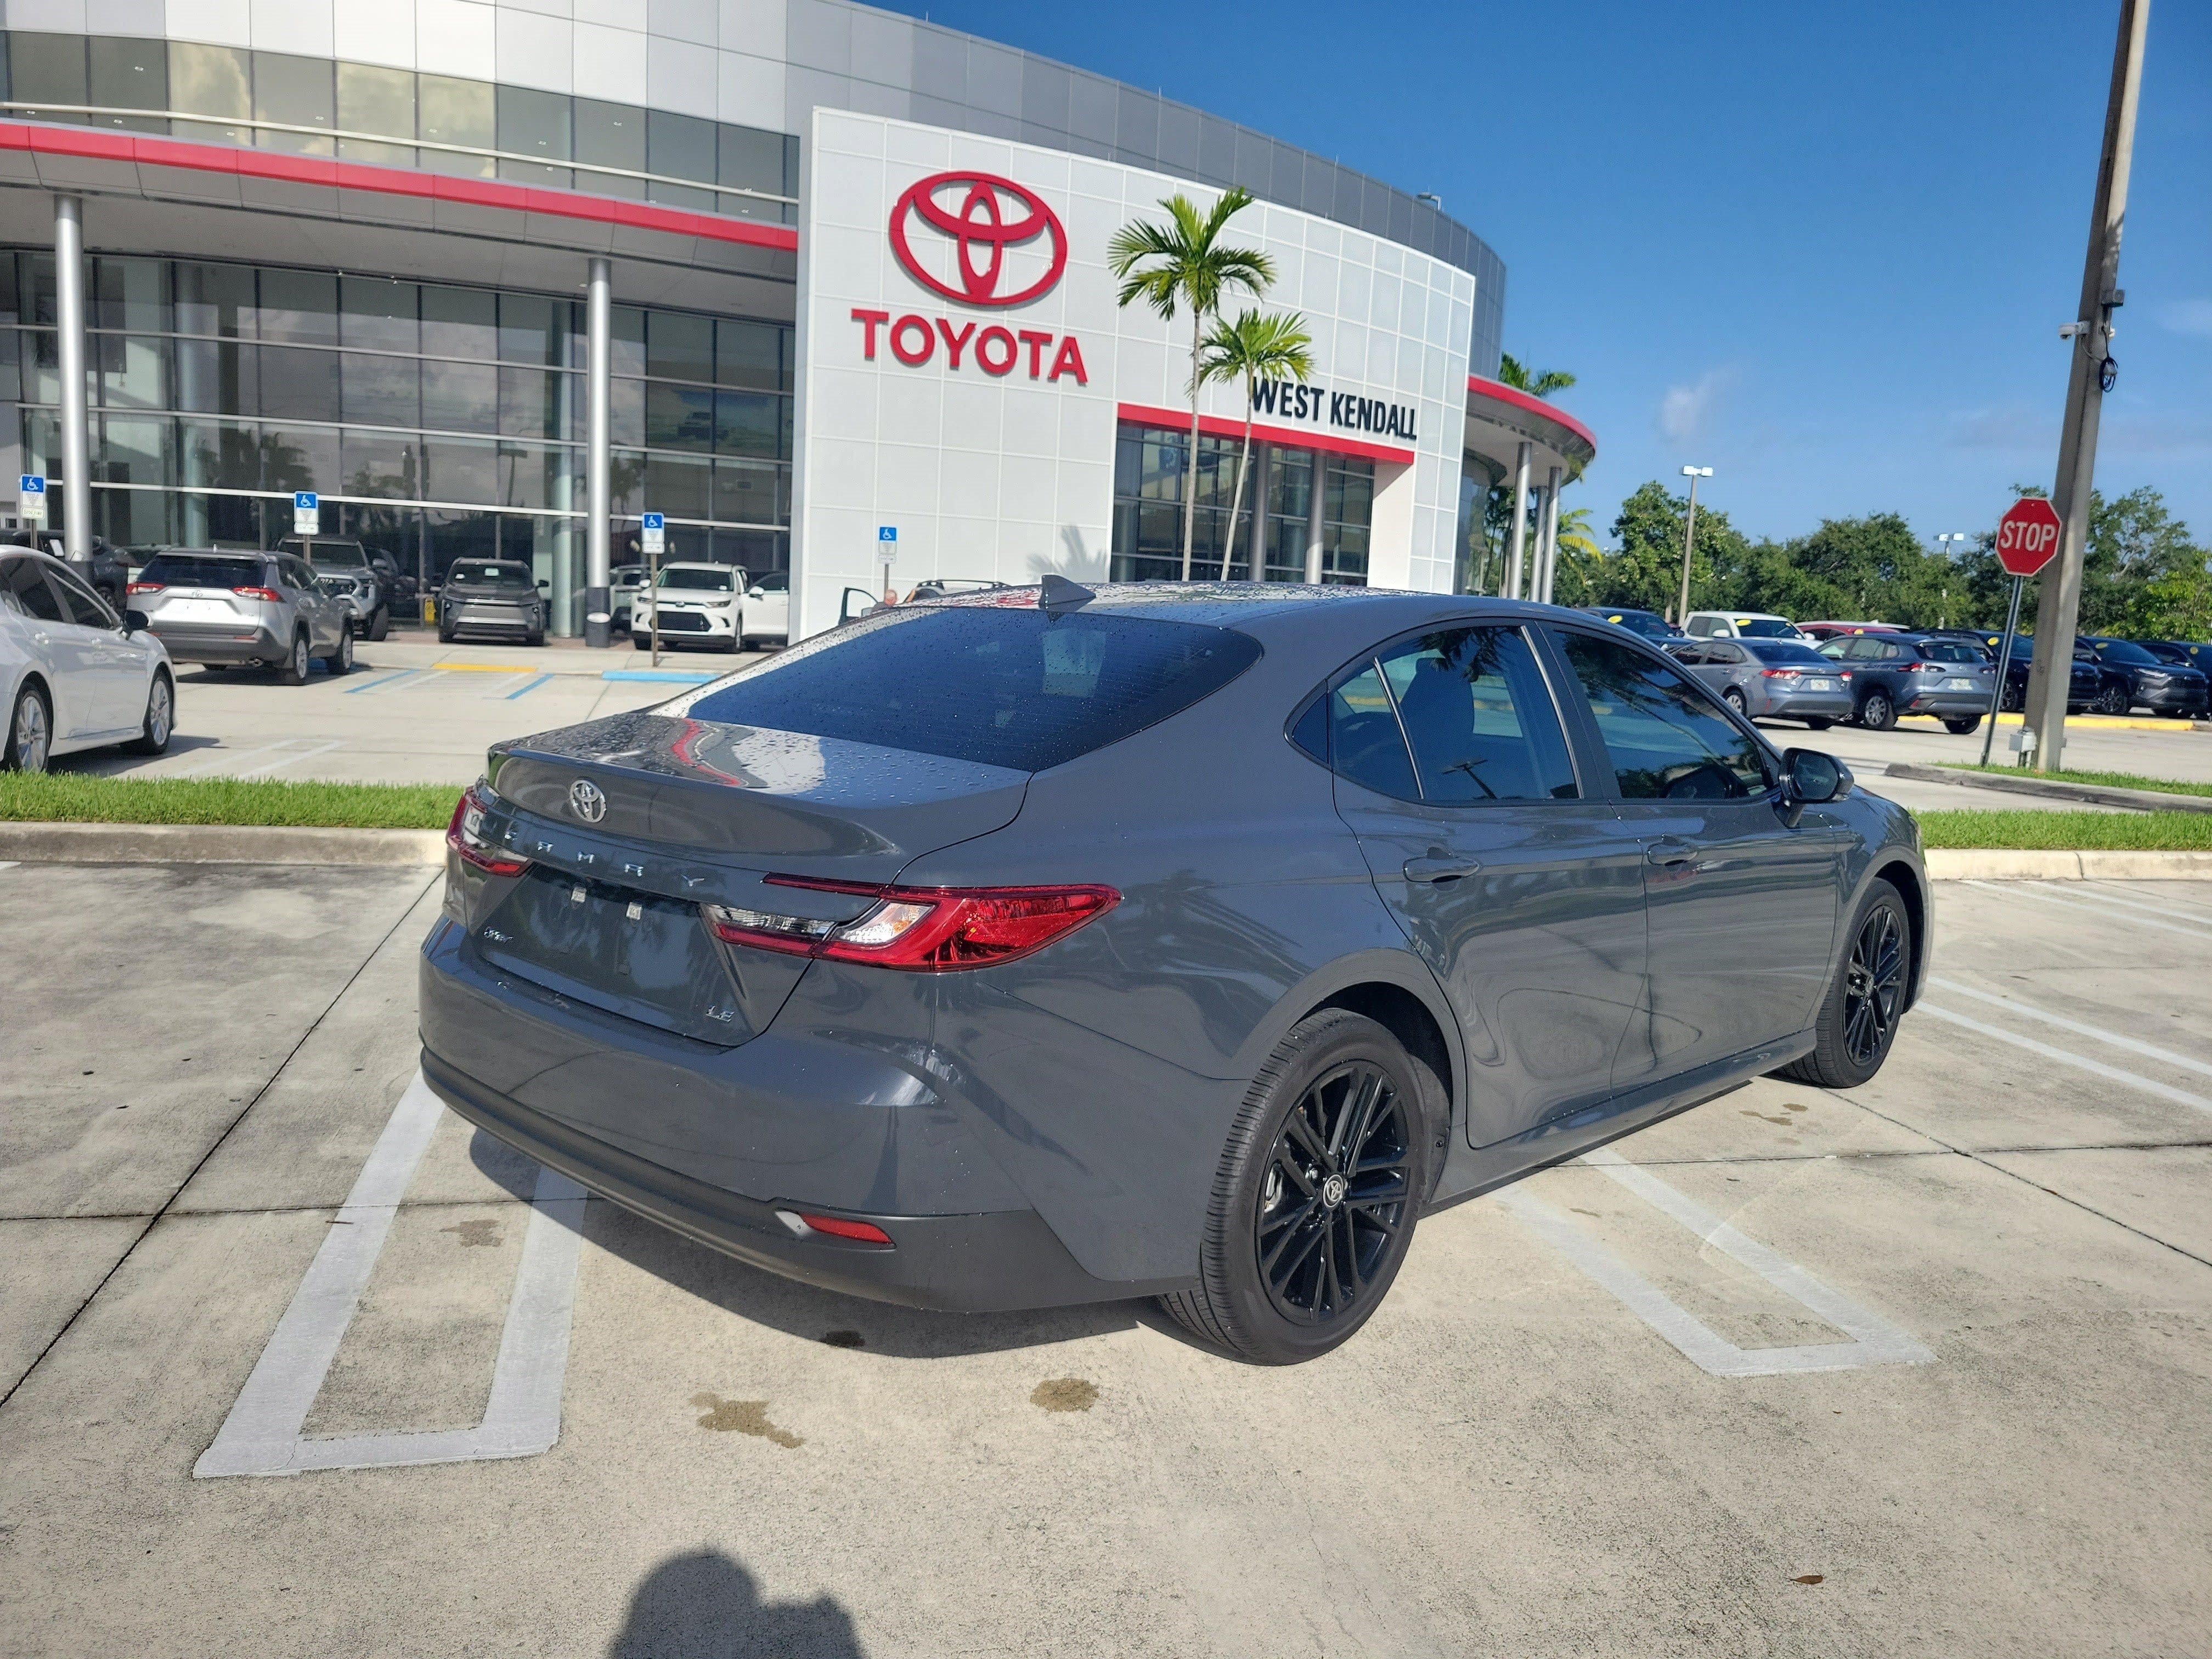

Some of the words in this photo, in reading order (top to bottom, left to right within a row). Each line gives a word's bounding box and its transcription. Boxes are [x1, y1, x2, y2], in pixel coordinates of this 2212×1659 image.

[851, 308, 1088, 385] TOYOTA
[1252, 376, 1324, 421] WEST
[1330, 392, 1417, 440] KENDALL
[2000, 520, 2056, 552] STOP
